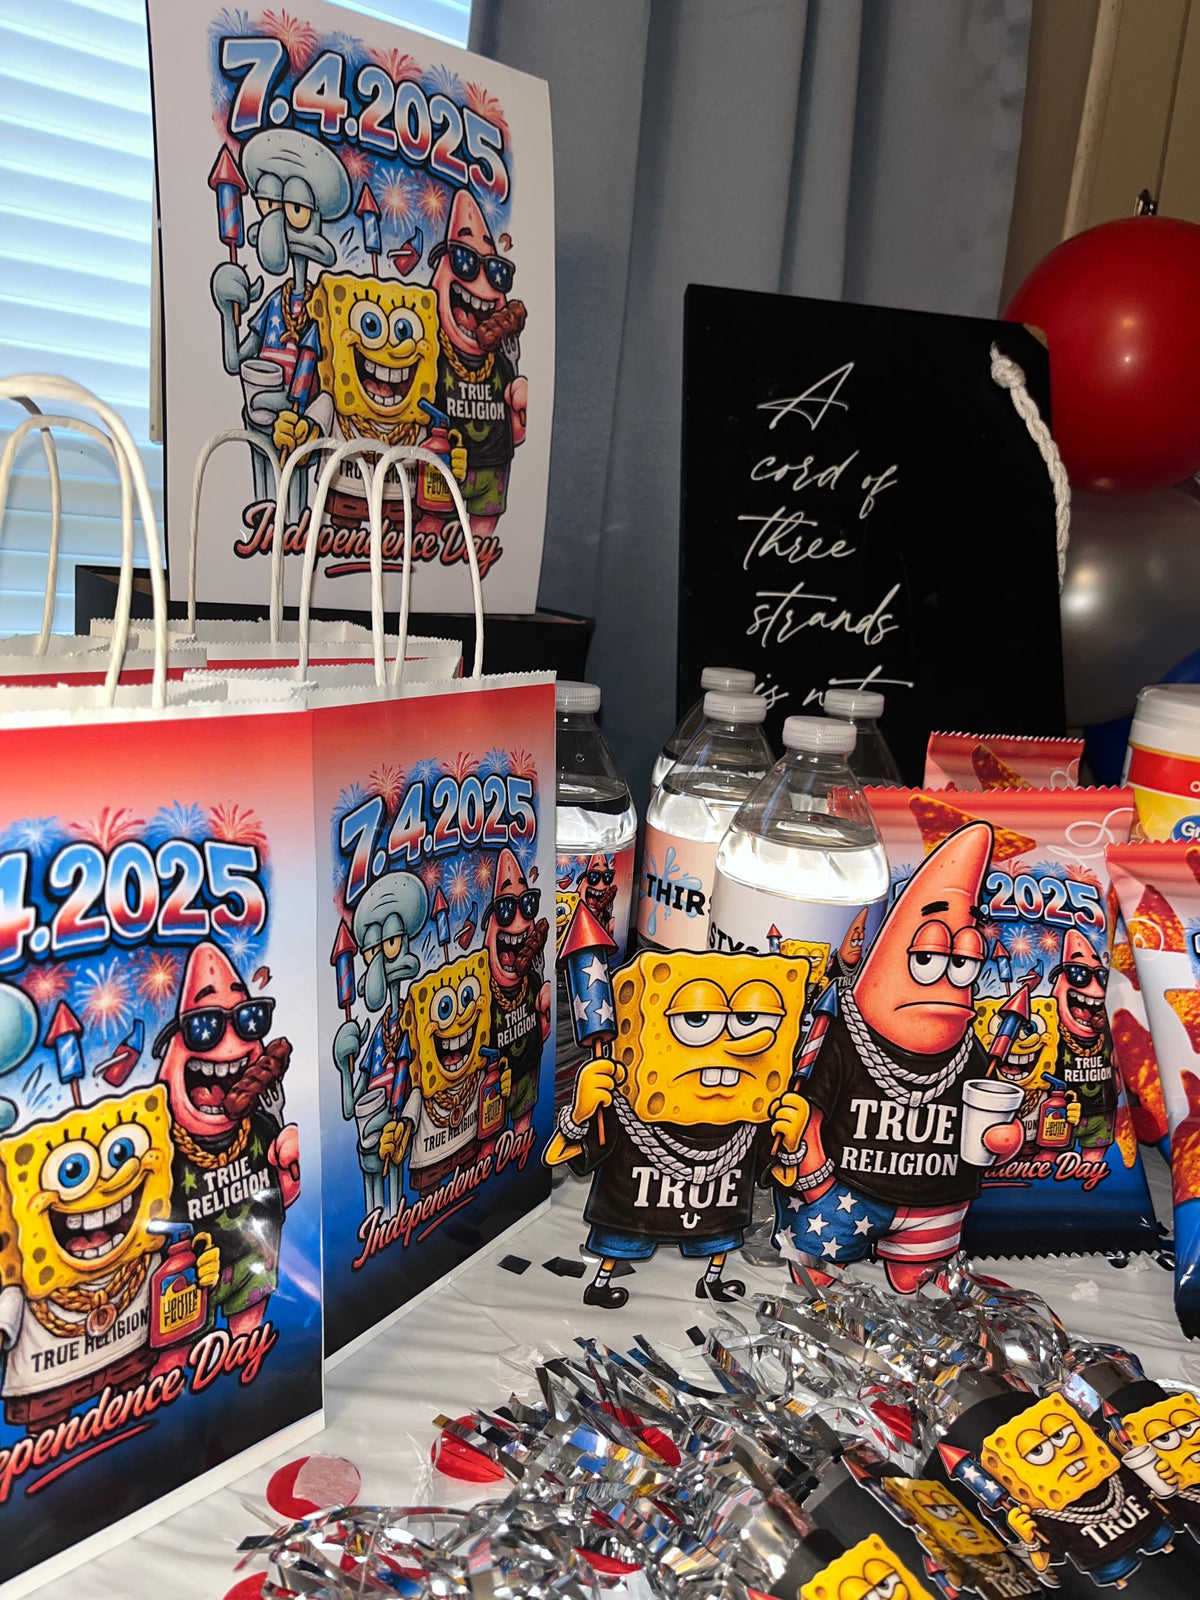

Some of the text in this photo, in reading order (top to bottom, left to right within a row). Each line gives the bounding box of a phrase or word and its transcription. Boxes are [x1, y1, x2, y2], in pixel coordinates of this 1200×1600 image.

[220, 37, 511, 204] 7.4.2025
[458, 381, 493, 401] TRUE
[756, 361, 854, 431] A
[340, 458, 371, 482] TRU
[750, 449, 898, 520] cord of
[737, 505, 857, 571] three
[746, 581, 901, 648] strands
[339, 775, 537, 905] 7.4.2025
[709, 921, 759, 953] STY
[504, 1003, 528, 1029] TRUE
[1075, 1056, 1103, 1069] TRUE
[424, 1130, 447, 1153] TRUE
[850, 1098, 958, 1145] TRUE
[203, 1156, 252, 1193] TRUE
[840, 1146, 959, 1176] RELIGION
[1055, 1151, 1111, 1191] Day
[352, 1127, 537, 1269] Independence Day
[631, 1166, 743, 1209] TRUE
[31, 1340, 80, 1373] TRUE
[189, 1324, 277, 1383] Day
[1080, 1494, 1150, 1549] TRUE
